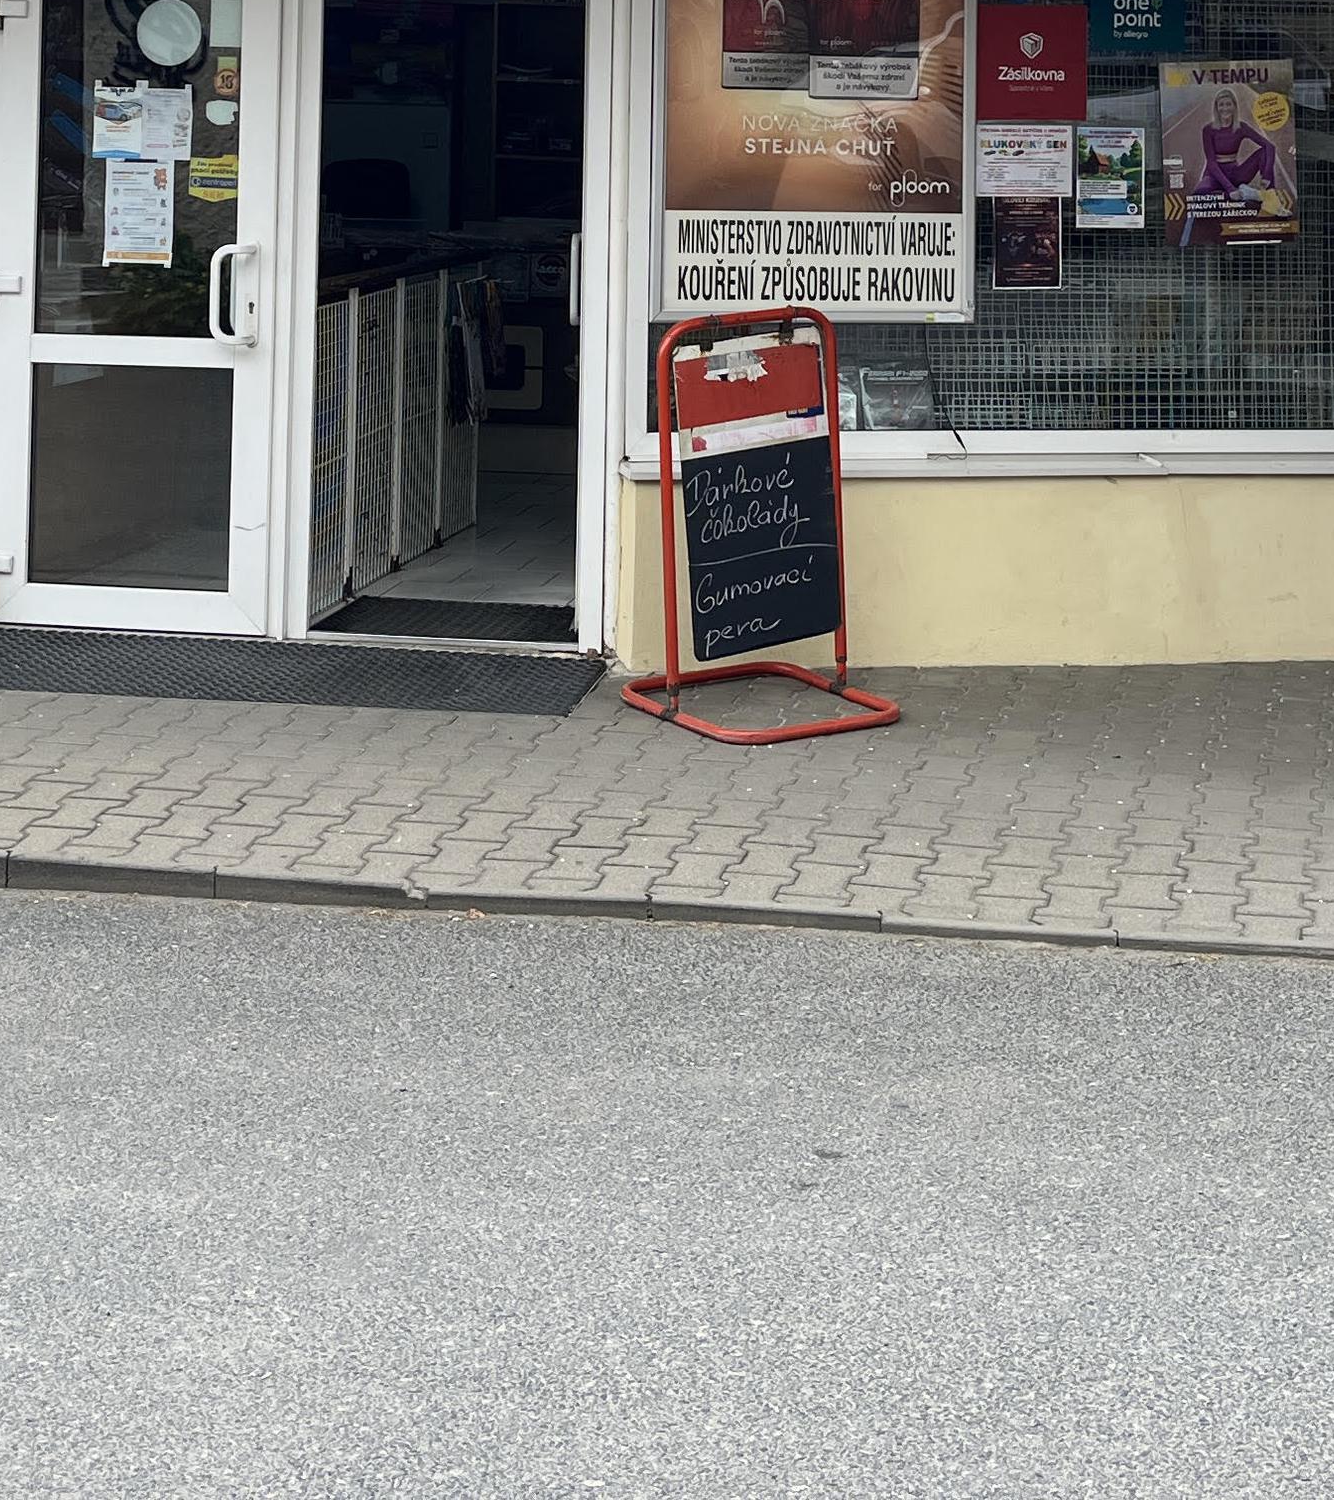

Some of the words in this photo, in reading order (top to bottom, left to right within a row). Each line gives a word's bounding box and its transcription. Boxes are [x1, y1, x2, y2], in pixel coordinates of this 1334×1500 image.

[1113, 11, 1162, 29] point
[1123, 30, 1149, 40] allegro
[879, 62, 912, 72] výrobek
[997, 66, 1066, 82] Zásilkovna
[1192, 70, 1206, 85] V
[1210, 67, 1269, 85] TEMPU
[811, 112, 899, 133] ZNAČKA
[835, 137, 896, 157] CHUŤ
[868, 182, 883, 192] for
[890, 169, 950, 208] ploom
[677, 218, 782, 255] MINISTERSTVO
[786, 215, 897, 256] ZDRAVOTNICTVÍ
[900, 221, 956, 257] VARUJE:
[677, 258, 757, 301] KOUŘENÍ
[760, 257, 862, 302] ZPŮSOBUJE
[868, 266, 956, 302] RAKOVINU
[686, 452, 795, 518] Dárkové
[700, 495, 811, 549] čokolády
[695, 554, 813, 614] Gumovací
[704, 617, 783, 658] pera
